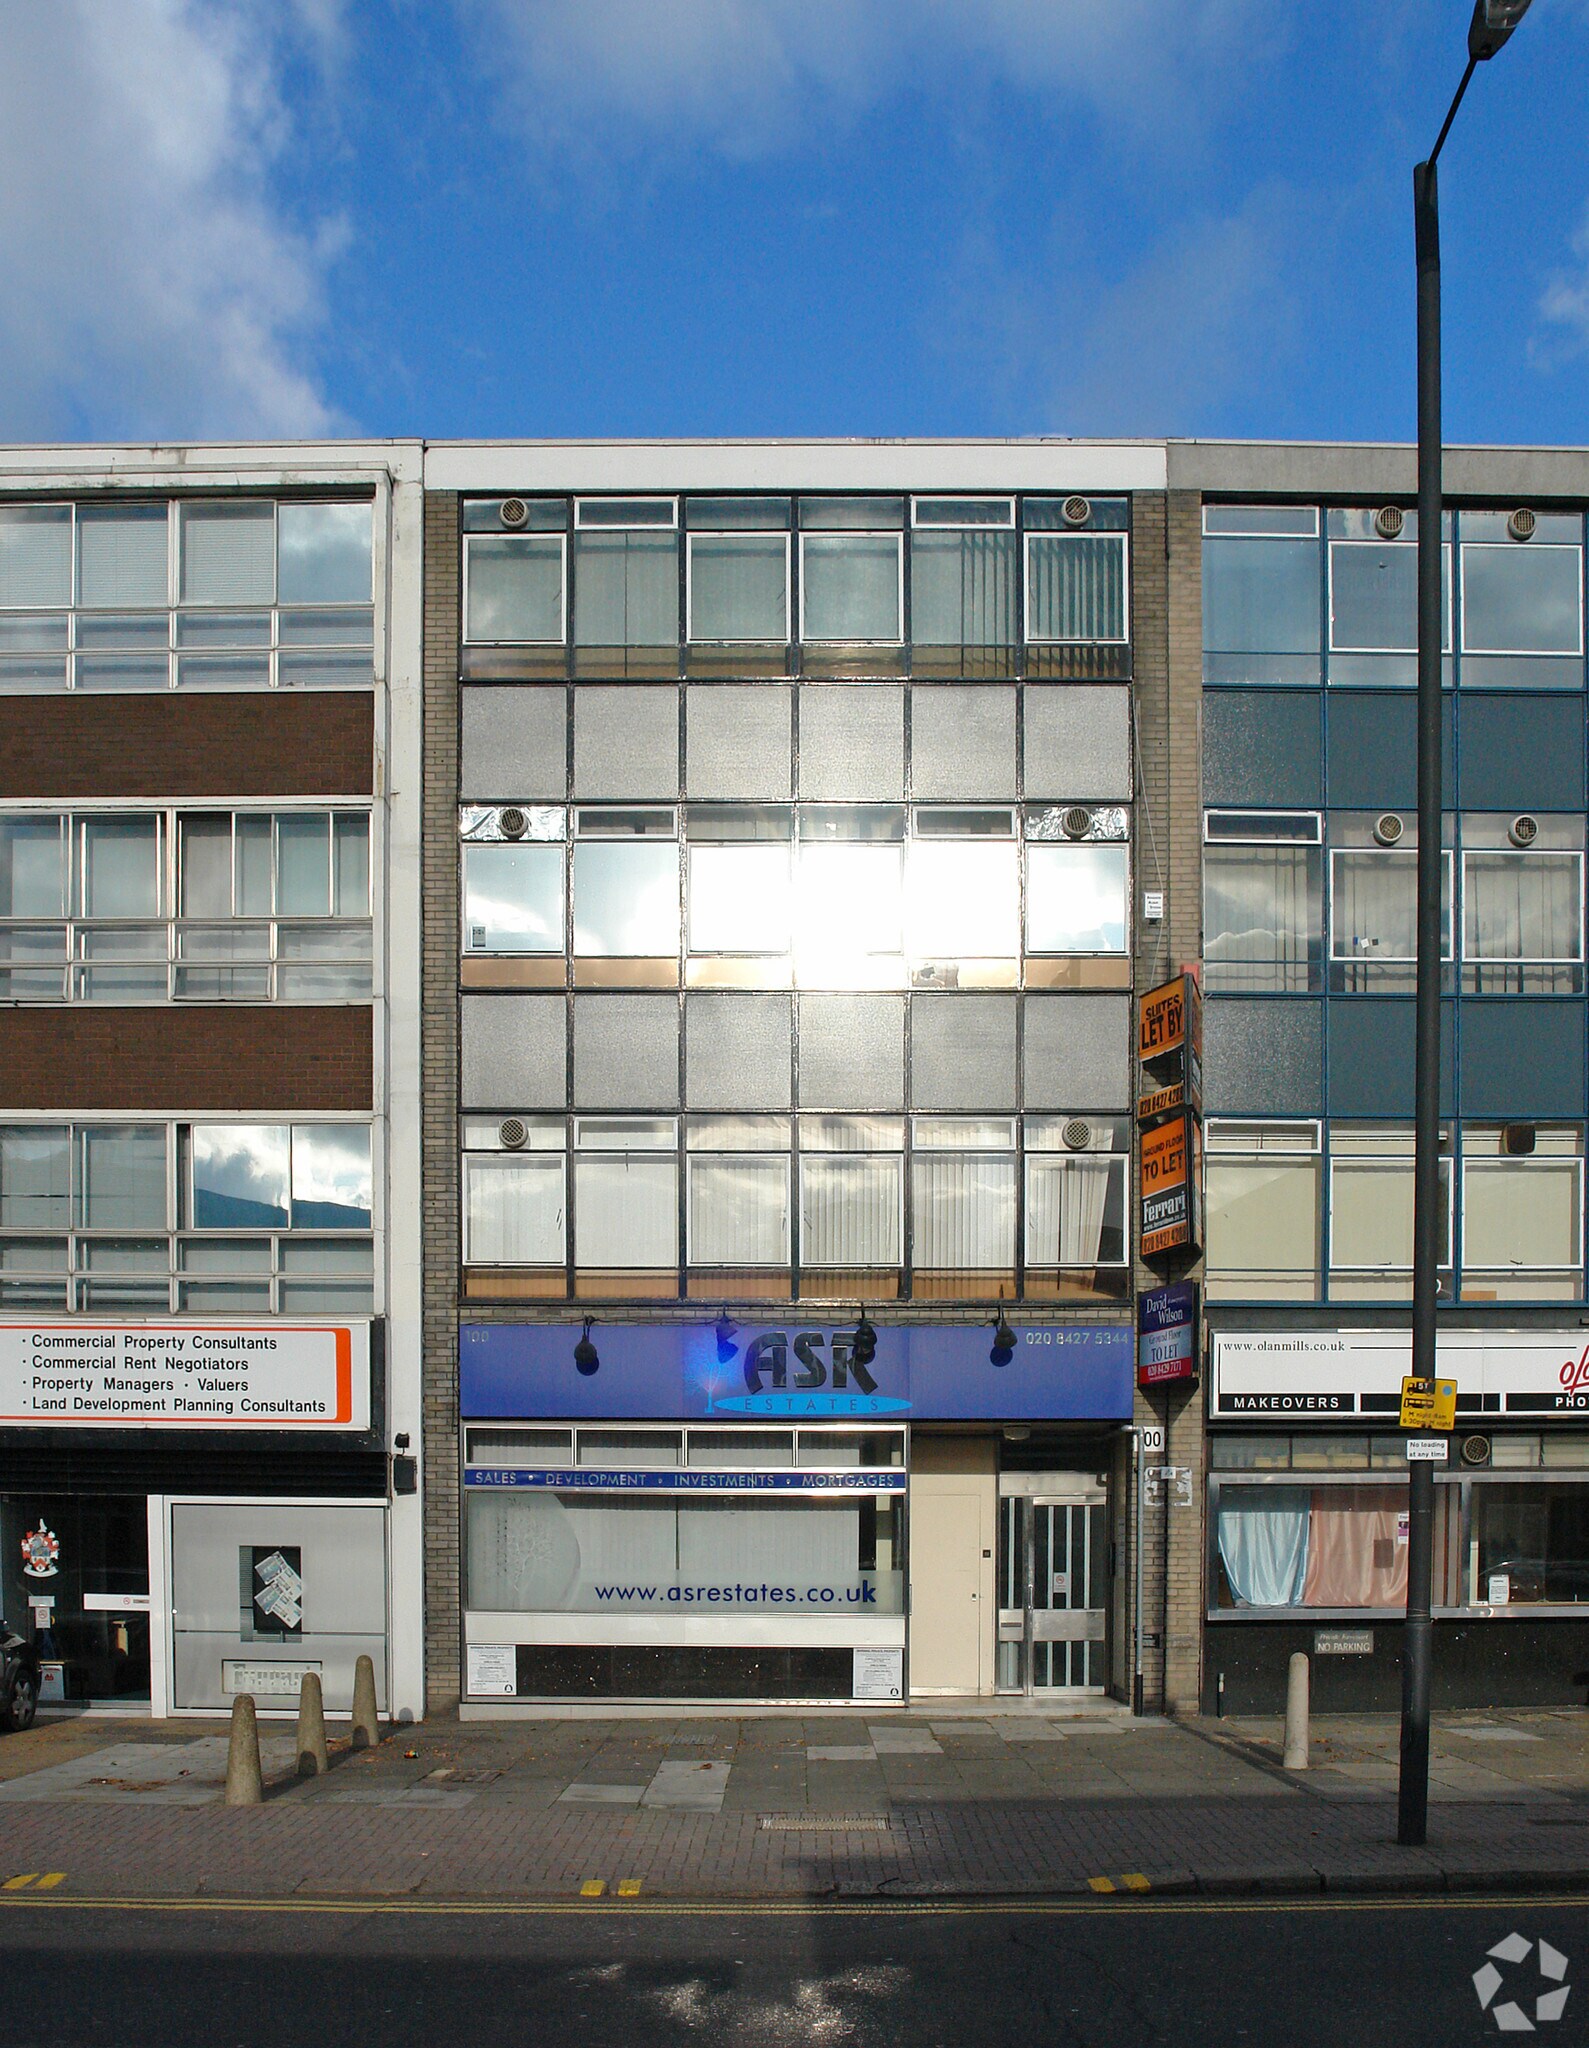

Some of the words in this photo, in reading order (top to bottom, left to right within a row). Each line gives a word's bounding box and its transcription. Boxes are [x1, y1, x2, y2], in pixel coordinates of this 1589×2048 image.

[1145, 994, 1180, 1021] SUITES
[1141, 1016, 1164, 1050] LET
[1167, 1003, 1183, 1038] BY
[1143, 1161, 1158, 1182] TO
[1162, 1149, 1183, 1175] LET
[1143, 1190, 1185, 1224] Ferrari
[1146, 1294, 1167, 1314] David
[1158, 1308, 1183, 1325] Wilson
[32, 1334, 116, 1349] Commercial
[124, 1336, 185, 1352] Property
[192, 1336, 278, 1350] Consultants
[465, 1330, 489, 1342] 100
[1026, 1332, 1051, 1345] 020
[1056, 1332, 1090, 1345] 8427
[1149, 1331, 1167, 1345] Ground
[1168, 1329, 1182, 1340] Floor
[1151, 1346, 1162, 1362] TO
[1164, 1344, 1179, 1359] LET
[1224, 1341, 1345, 1352] www.olanmills.co.uk
[32, 1355, 116, 1370] Commercial
[124, 1356, 156, 1370] Rent
[165, 1357, 249, 1373] Negotiators
[743, 1332, 879, 1395] ASR
[32, 1376, 94, 1393] Property
[103, 1378, 174, 1394] Managers
[197, 1378, 249, 1391] Valuers
[32, 1397, 67, 1410] Land
[73, 1397, 166, 1414] Development
[174, 1398, 234, 1414] Planning
[240, 1398, 326, 1413] Consultants
[744, 1397, 880, 1412] ESTATES
[1233, 1397, 1340, 1409] MAKEOVERS
[1555, 1397, 1589, 1407] PHO
[1145, 1432, 1160, 1446] 00
[1421, 1441, 1445, 1449] loading
[475, 1471, 517, 1485] SALES
[545, 1473, 647, 1486] DEVELOPMENT
[674, 1473, 775, 1487] INVESTMENTS
[802, 1474, 895, 1487] MORTGAGES
[595, 1580, 877, 1603] www.asrestates.co.uk
[1318, 1643, 1330, 1651] NO
[1334, 1643, 1370, 1651] PARKING
